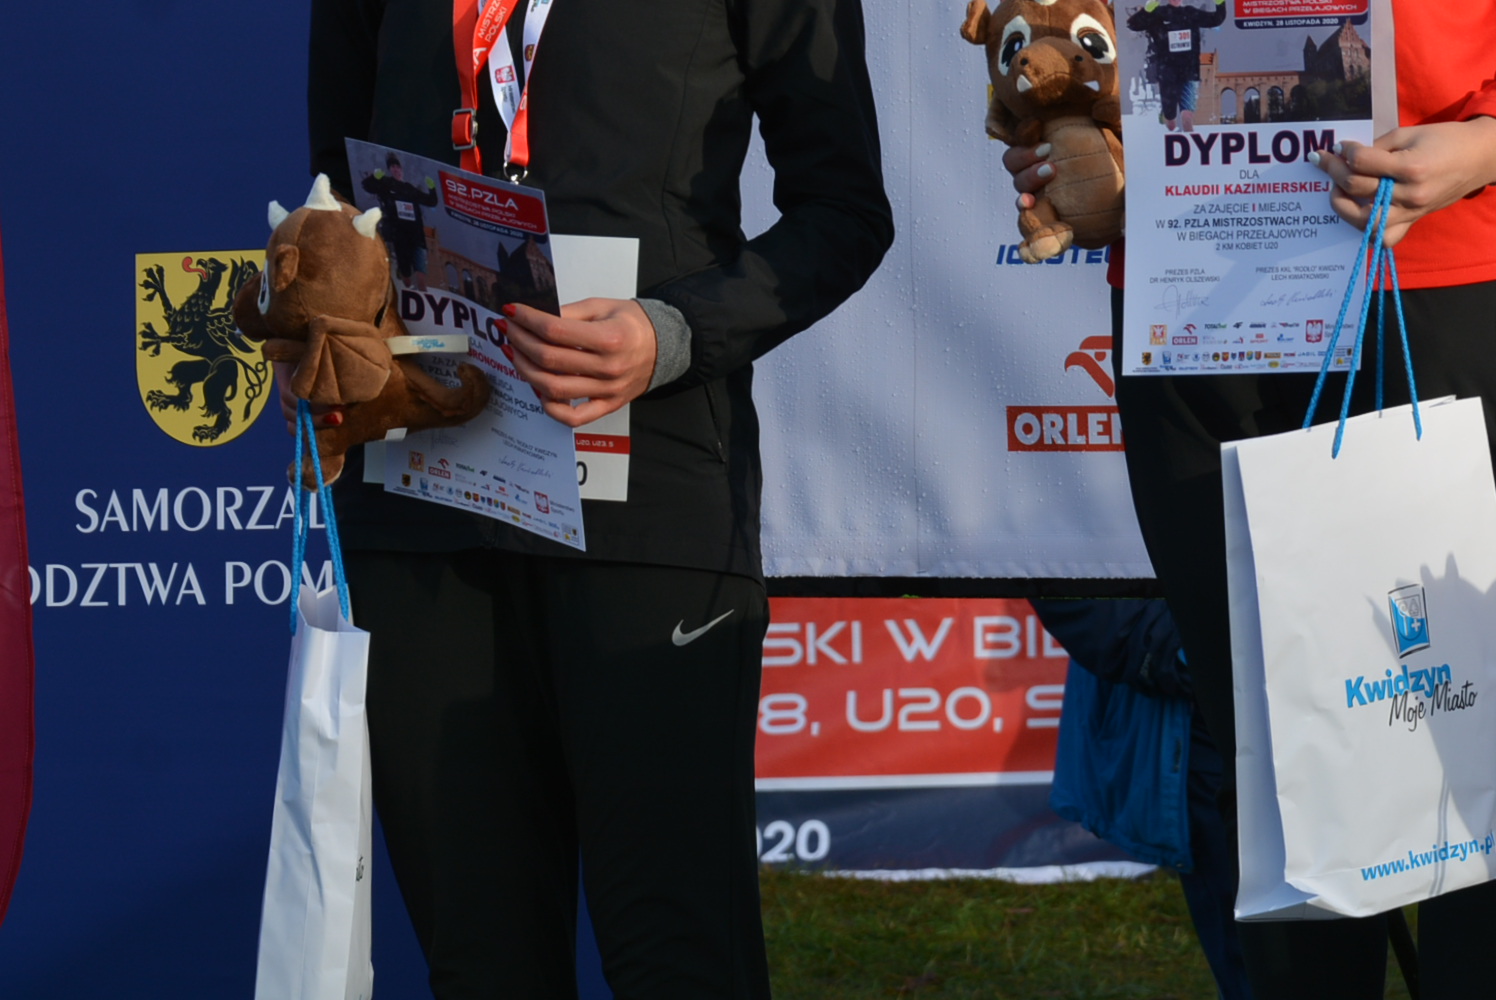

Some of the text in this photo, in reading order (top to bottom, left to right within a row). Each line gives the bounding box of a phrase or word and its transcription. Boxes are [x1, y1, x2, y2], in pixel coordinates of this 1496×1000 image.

[485, 6, 507, 42] POLSKI
[1164, 129, 1335, 167] DYPLOM
[1165, 181, 1330, 197] KLAUDII KAZIMIERSKIEJ
[1239, 169, 1260, 180] DLA
[1155, 214, 1340, 229] W 92. PZLA MISTRZOSTWACH POLSKI
[1194, 204, 1207, 214] ZA
[1208, 203, 1250, 215] ZAJĘCIE
[1258, 202, 1303, 213] MIEJSCA
[1177, 228, 1318, 241] W BIEGACH PRZEŁAJOWYCH
[884, 617, 954, 662] W
[1345, 663, 1452, 709] Kwidzyn
[846, 685, 1004, 733] U20,
[1388, 679, 1478, 732] Moje Miasto
[1360, 830, 1496, 881] www.kwidzyn.pl
